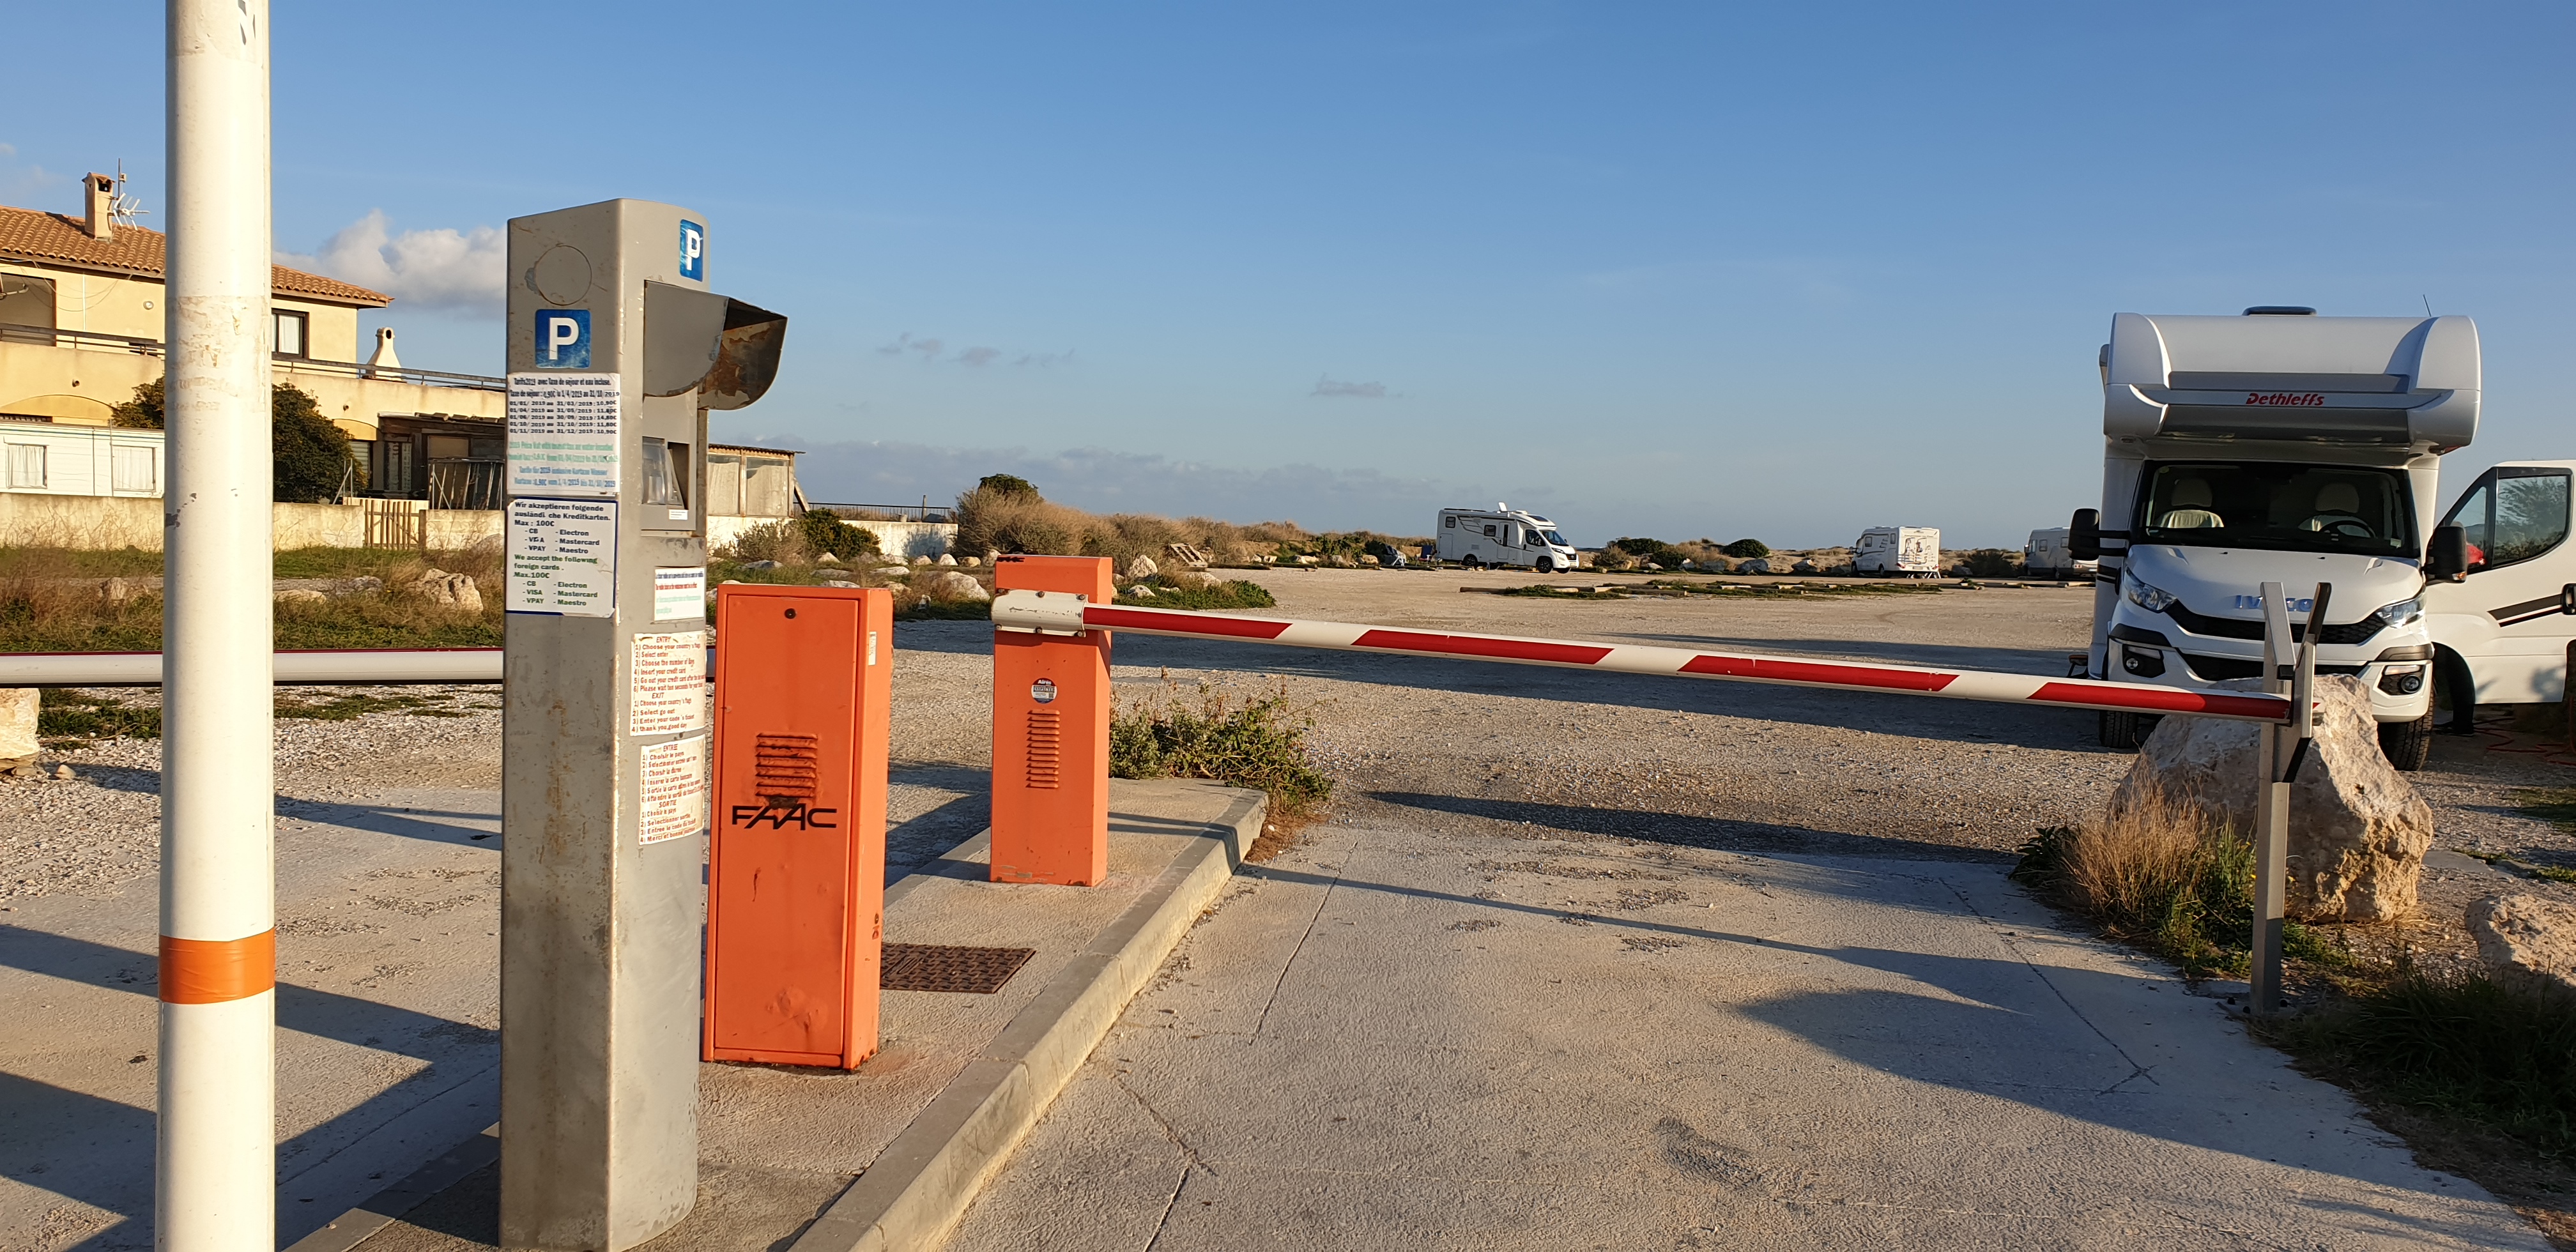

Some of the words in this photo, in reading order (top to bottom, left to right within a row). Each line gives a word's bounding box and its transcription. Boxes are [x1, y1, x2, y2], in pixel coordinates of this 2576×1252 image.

[686, 229, 701, 270] P
[548, 317, 578, 360] P
[2246, 393, 2324, 406] Dethleffs
[2235, 595, 2314, 612] IVCO
[659, 800, 677, 808] SORTIE
[732, 803, 837, 830] FAAC
[647, 833, 663, 841] Merci
